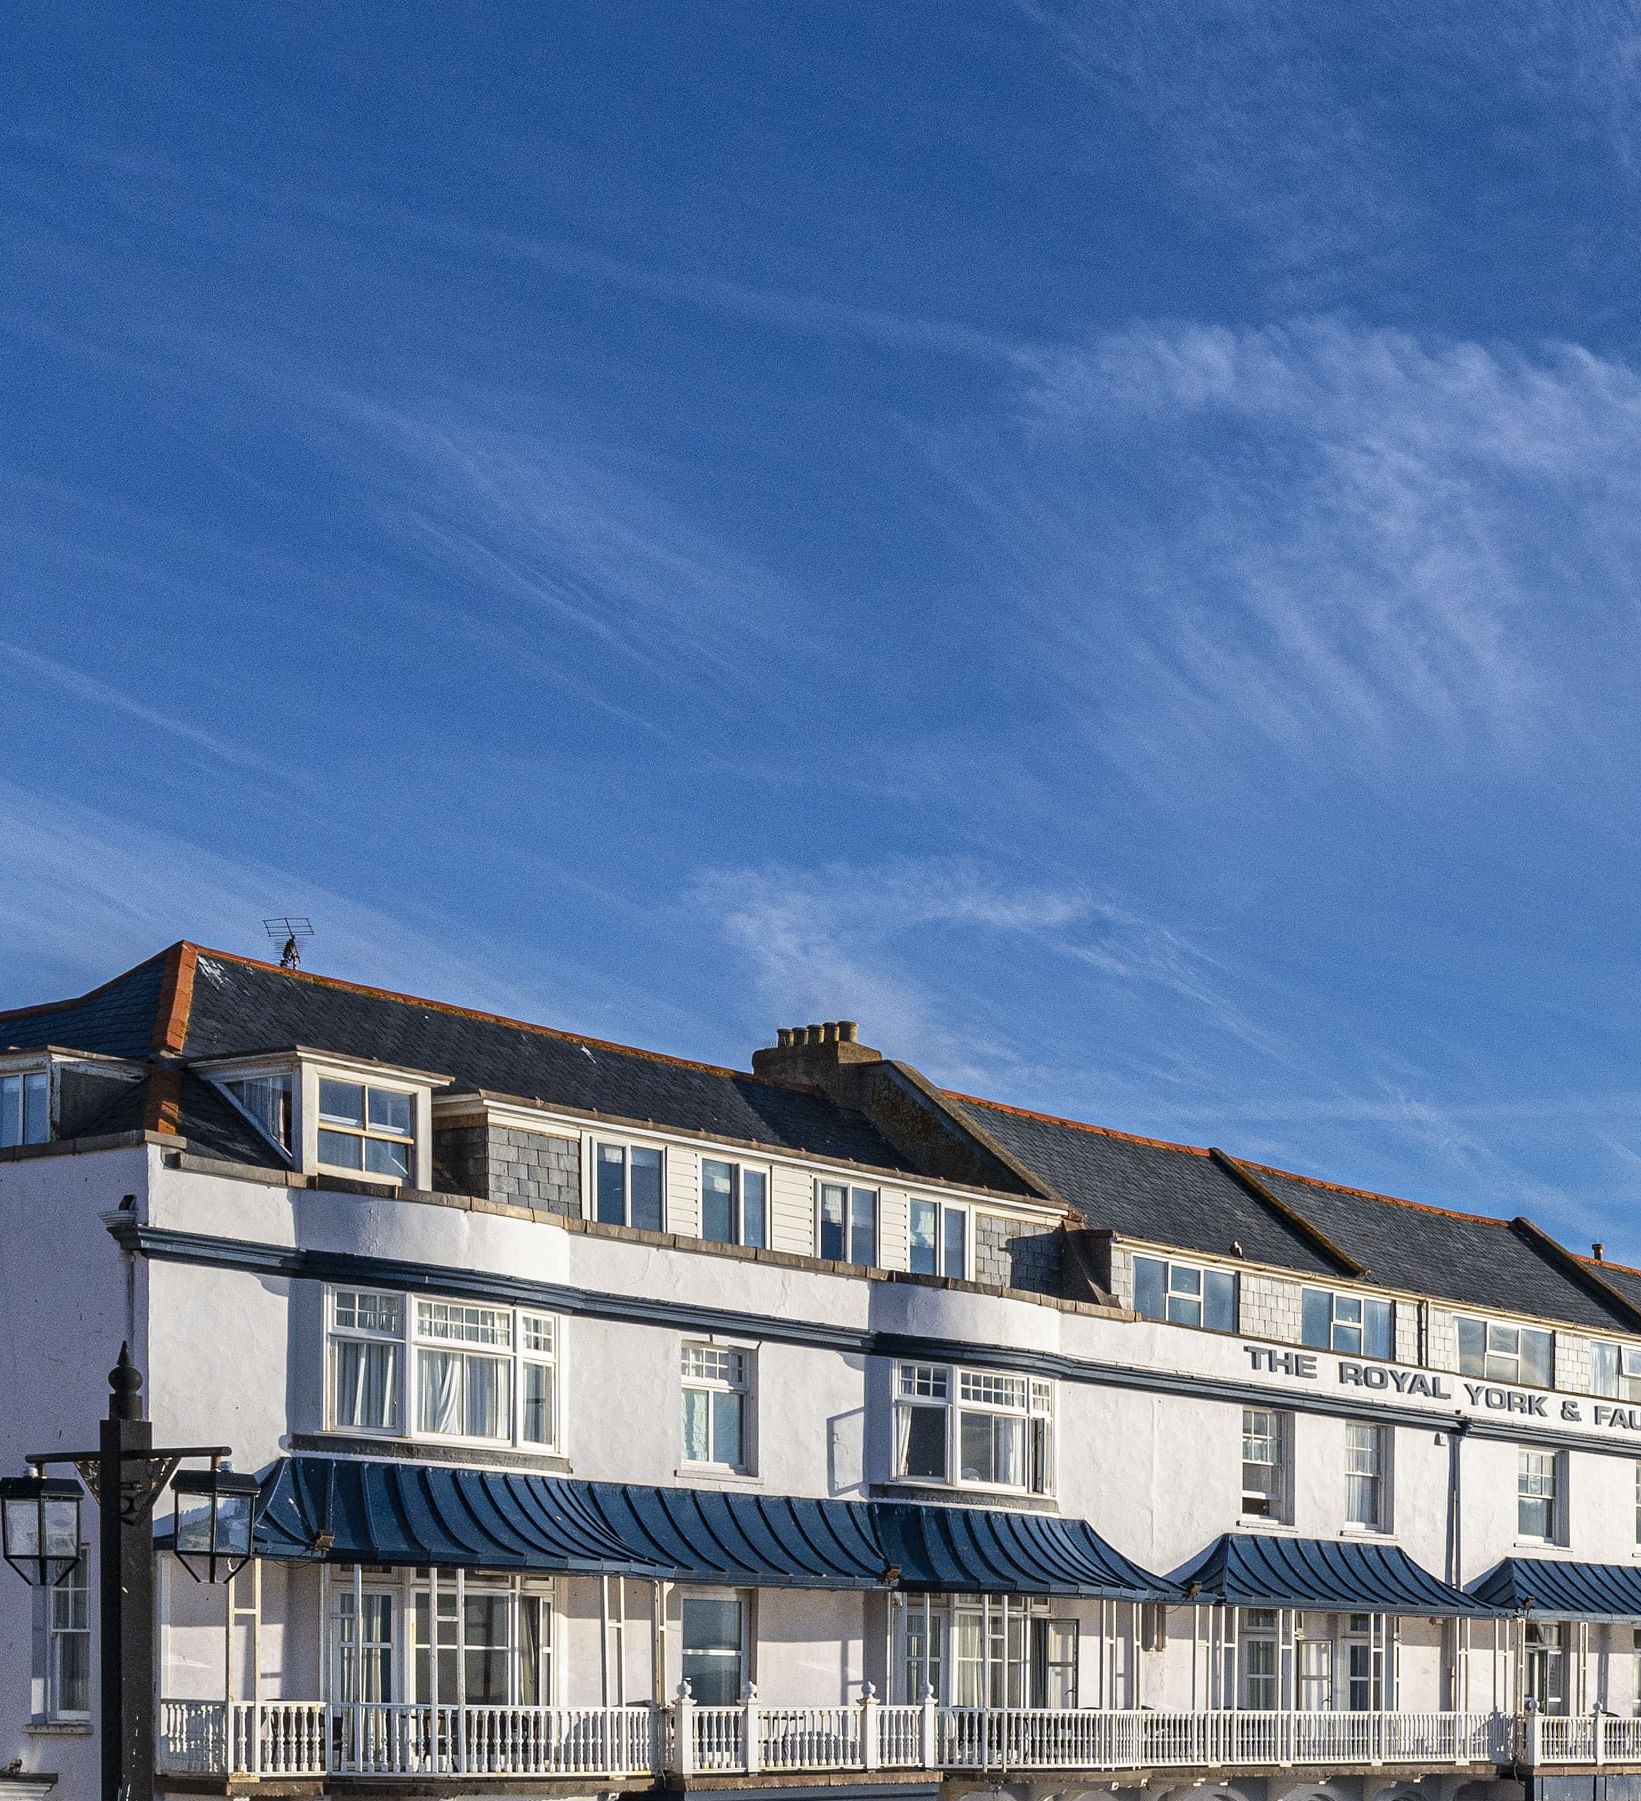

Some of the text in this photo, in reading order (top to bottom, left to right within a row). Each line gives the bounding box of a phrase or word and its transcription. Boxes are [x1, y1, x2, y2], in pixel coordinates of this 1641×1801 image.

[1244, 1345, 1317, 1378] THE
[1339, 1361, 1451, 1400] ROYAL
[1464, 1383, 1549, 1417] YORK
[1561, 1401, 1583, 1422] &
